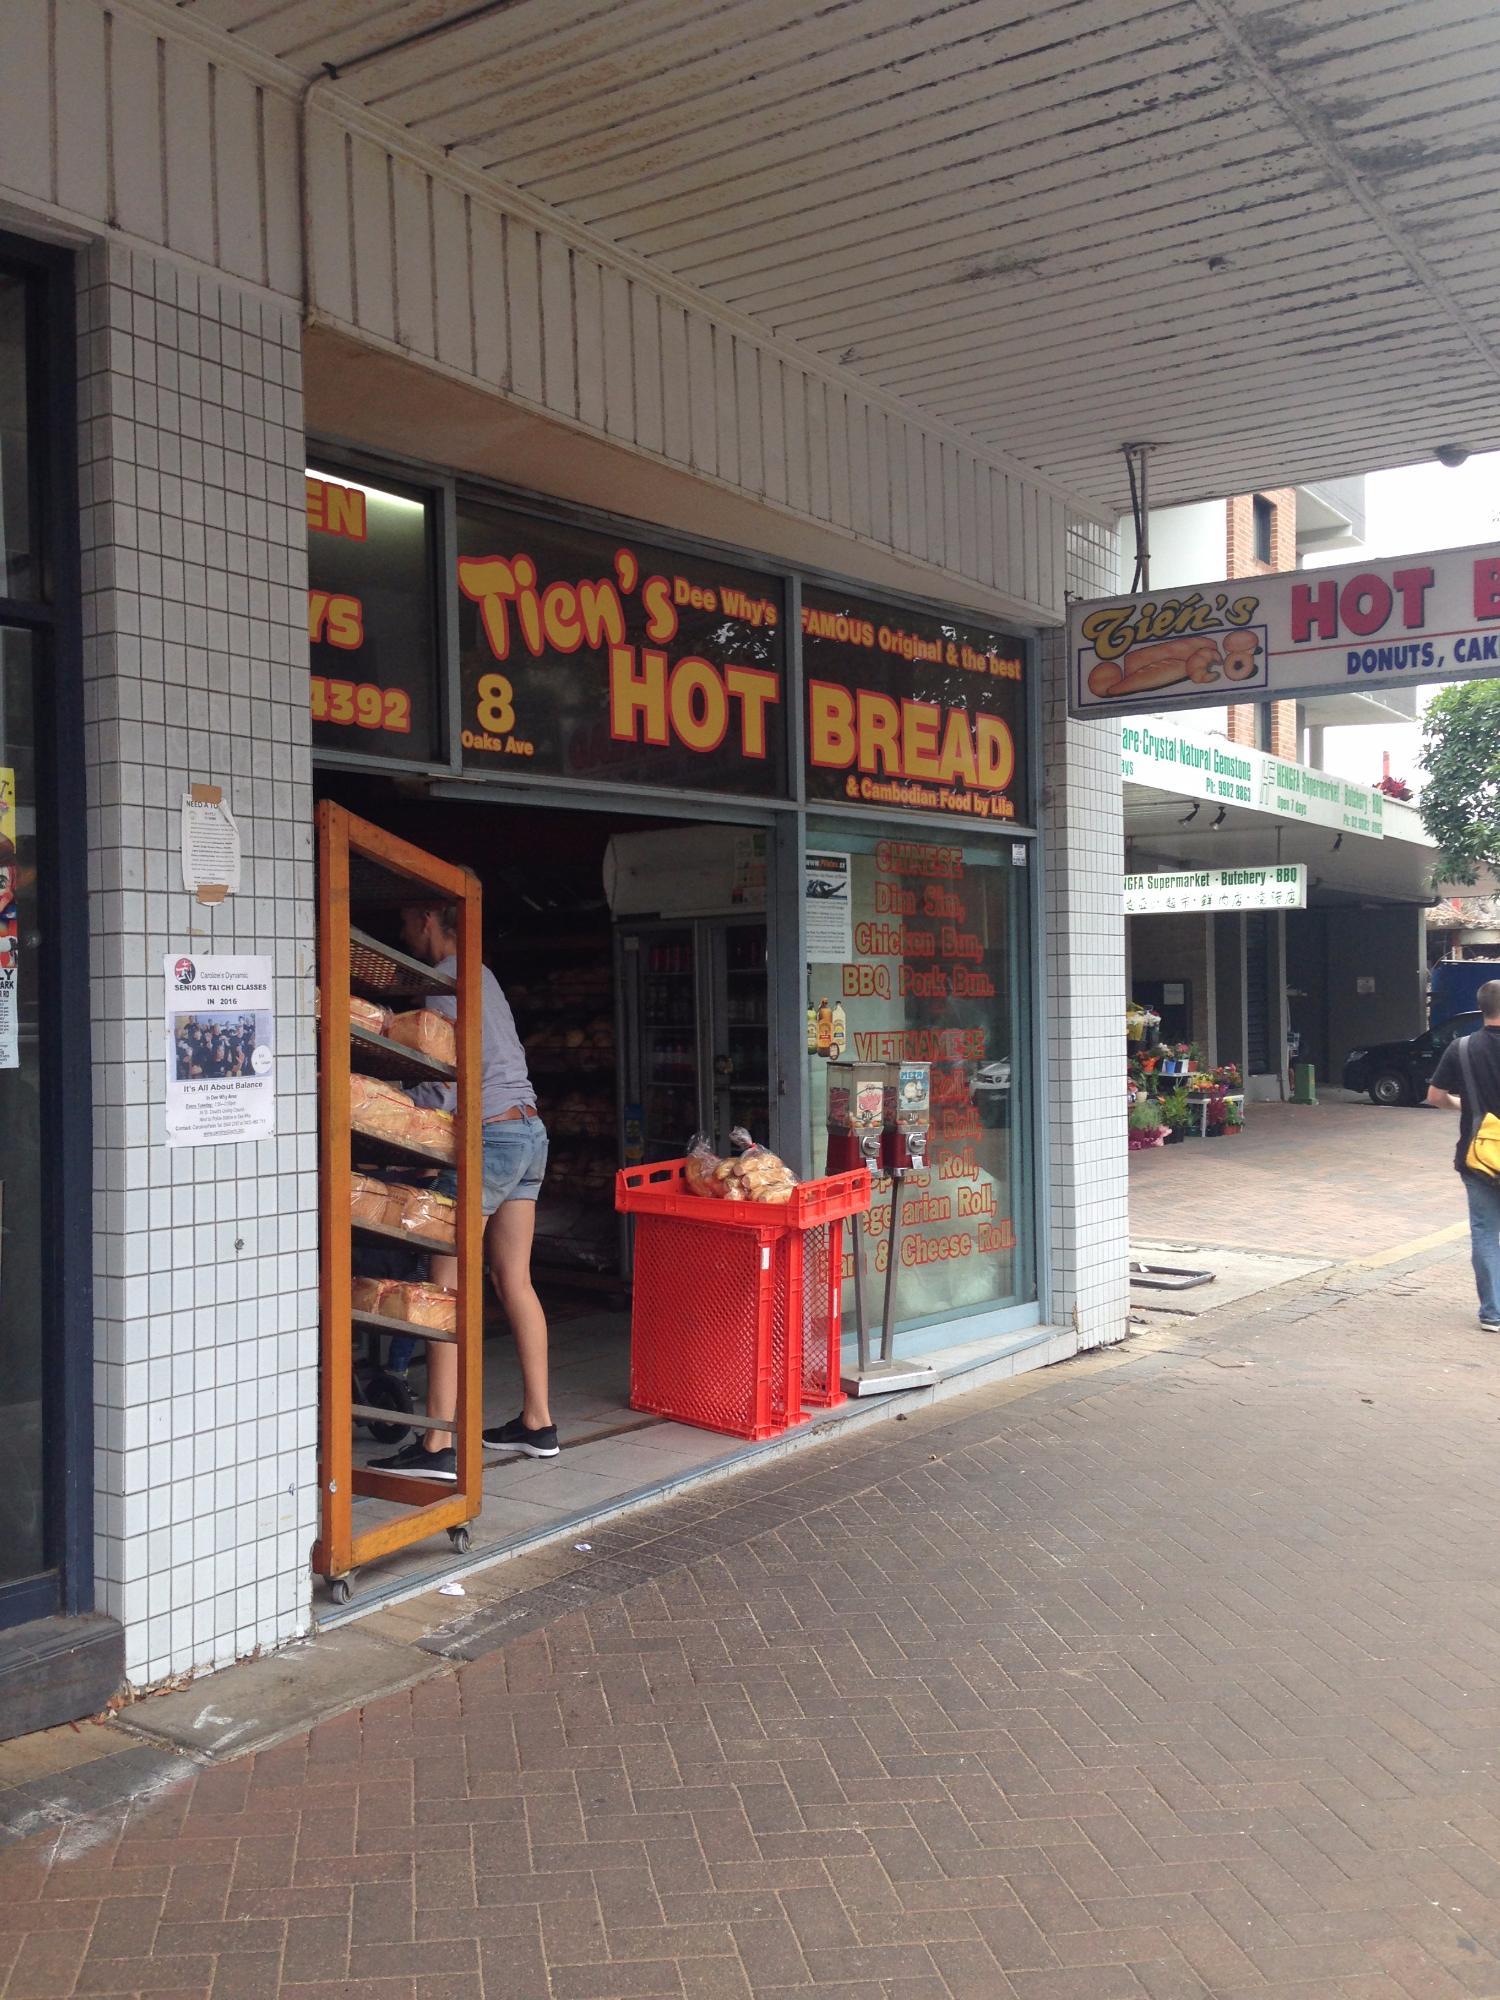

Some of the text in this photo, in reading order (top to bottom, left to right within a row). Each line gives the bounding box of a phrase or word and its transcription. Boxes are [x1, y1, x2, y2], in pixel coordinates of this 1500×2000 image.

[457, 548, 678, 660] Tien's
[673, 575, 778, 627] Dee Why's
[1291, 566, 1435, 644] HOT
[801, 605, 1022, 681] FAMOUS Original & the best
[476, 673, 516, 734] 8
[609, 643, 780, 759] HOT
[460, 729, 536, 758] Oaks Ave
[809, 679, 1015, 792] BREAD
[1213, 747, 1251, 782] Gemstone
[845, 774, 860, 798] &
[860, 776, 937, 808] Cambodian
[939, 788, 972, 812] Food
[973, 792, 989, 818] by
[875, 840, 964, 880] CHINESE
[1147, 872, 1210, 891] Supermarket
[1221, 871, 1266, 886] Butchery
[1276, 867, 1297, 884] BBQ
[875, 880, 916, 915] Dim
[854, 921, 936, 956] Chicken
[941, 926, 984, 965] Bun,
[236, 983, 267, 991] CLASSES
[842, 963, 891, 1000] BBQ
[898, 964, 947, 998] Pork
[854, 1027, 986, 1062] VIETNAMESE
[183, 1081, 263, 1093] It's All About Balance
[939, 1146, 979, 1182] Roll,
[844, 1182, 997, 1236] egearian Roll,
[901, 1232, 972, 1267] Cheese
